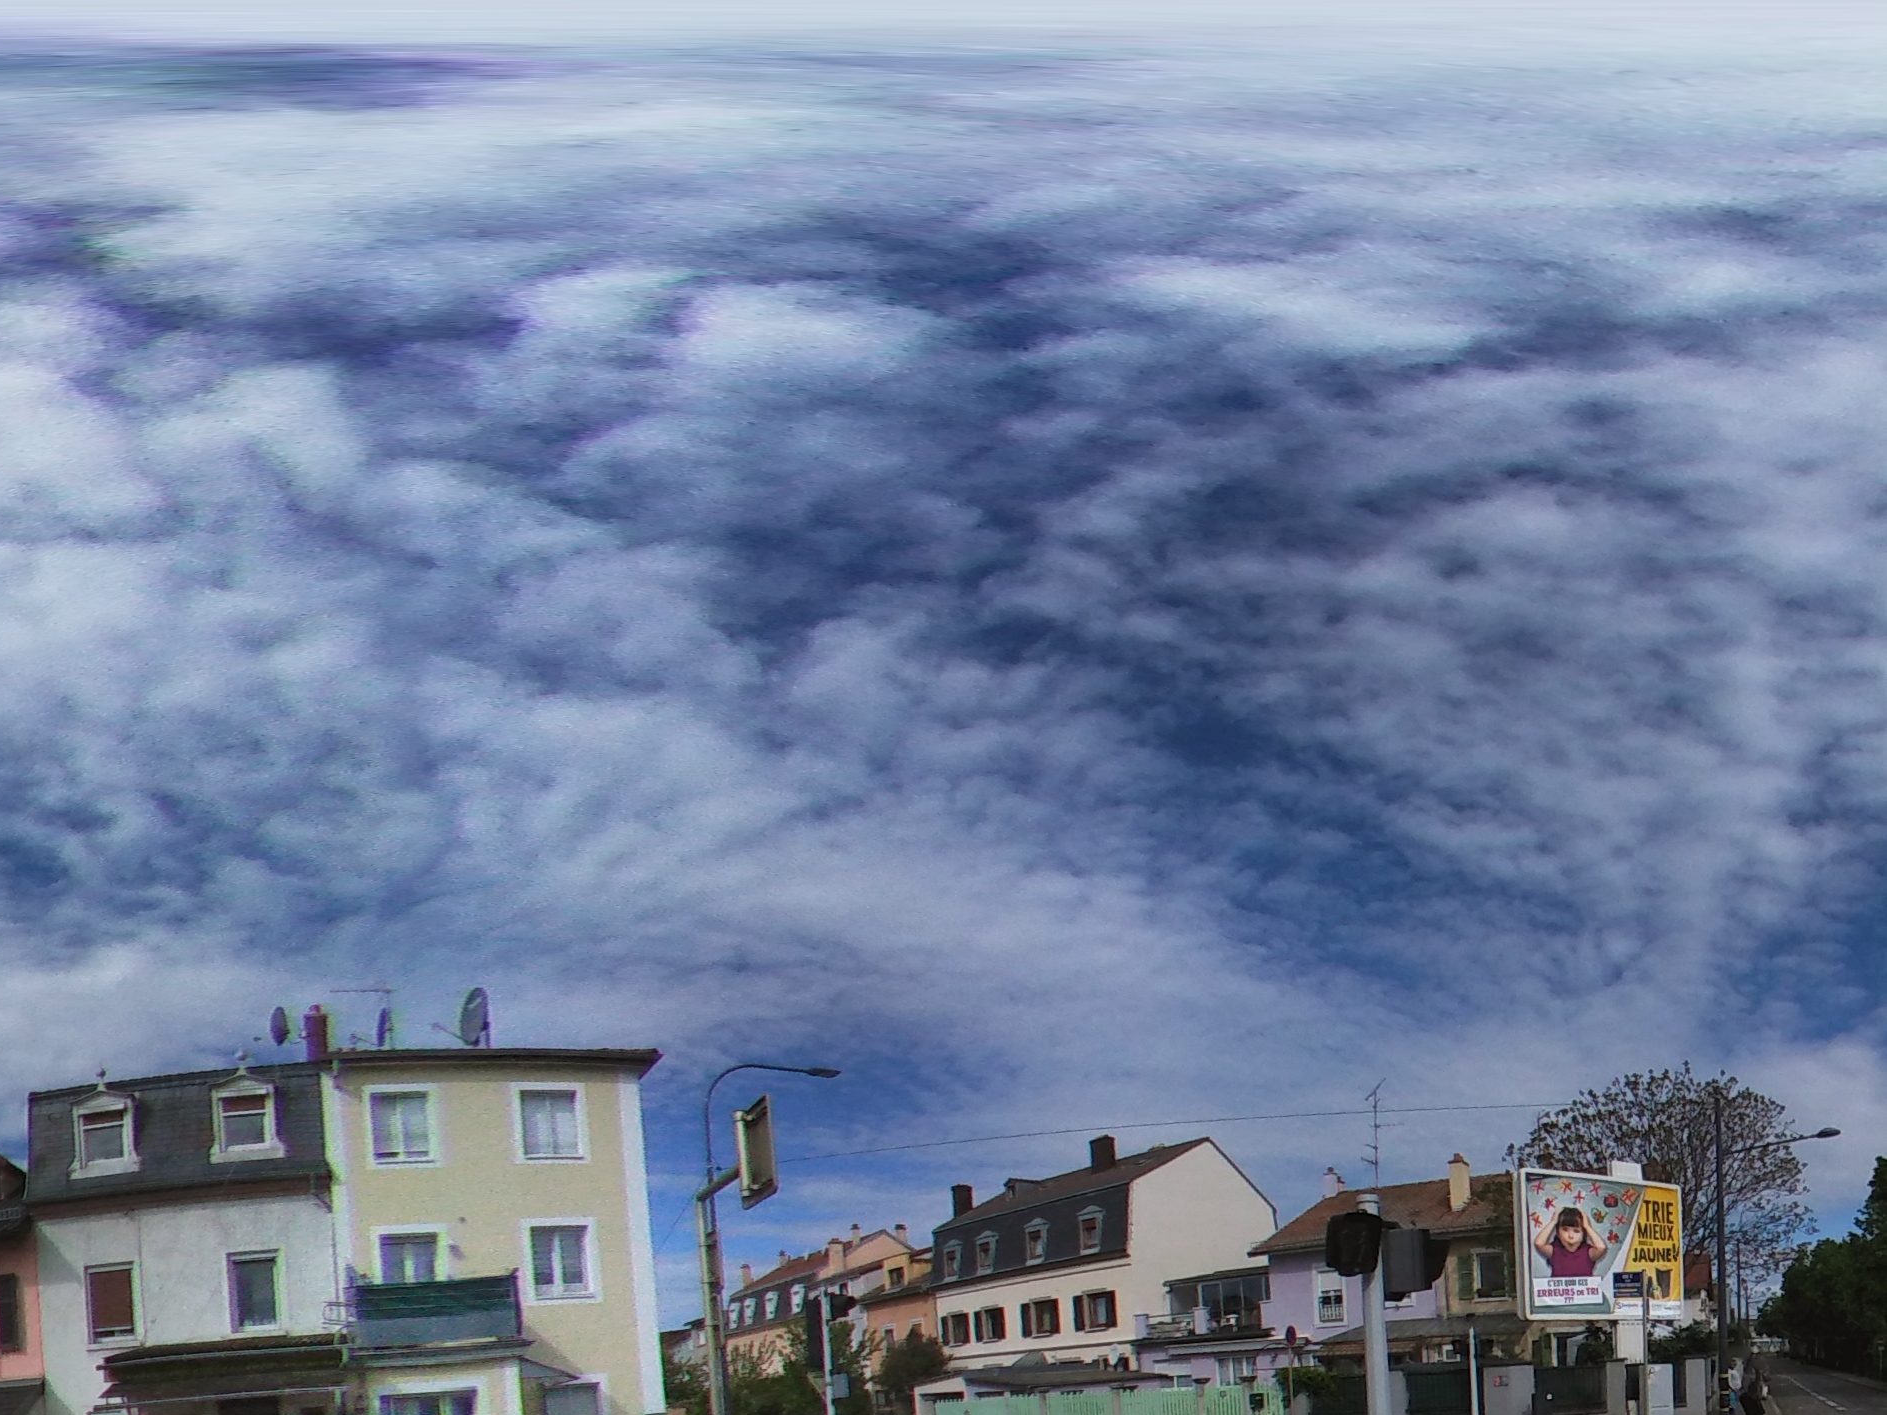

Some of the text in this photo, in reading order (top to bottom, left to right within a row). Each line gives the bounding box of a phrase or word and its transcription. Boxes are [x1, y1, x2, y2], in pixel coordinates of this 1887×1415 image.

[1643, 1200, 1674, 1224] TRIE
[1637, 1222, 1674, 1241] MIEUX
[1547, 1279, 1563, 1287] C'EST
[1537, 1288, 1575, 1297] ERREURS
[1586, 1287, 1599, 1295] TRI
